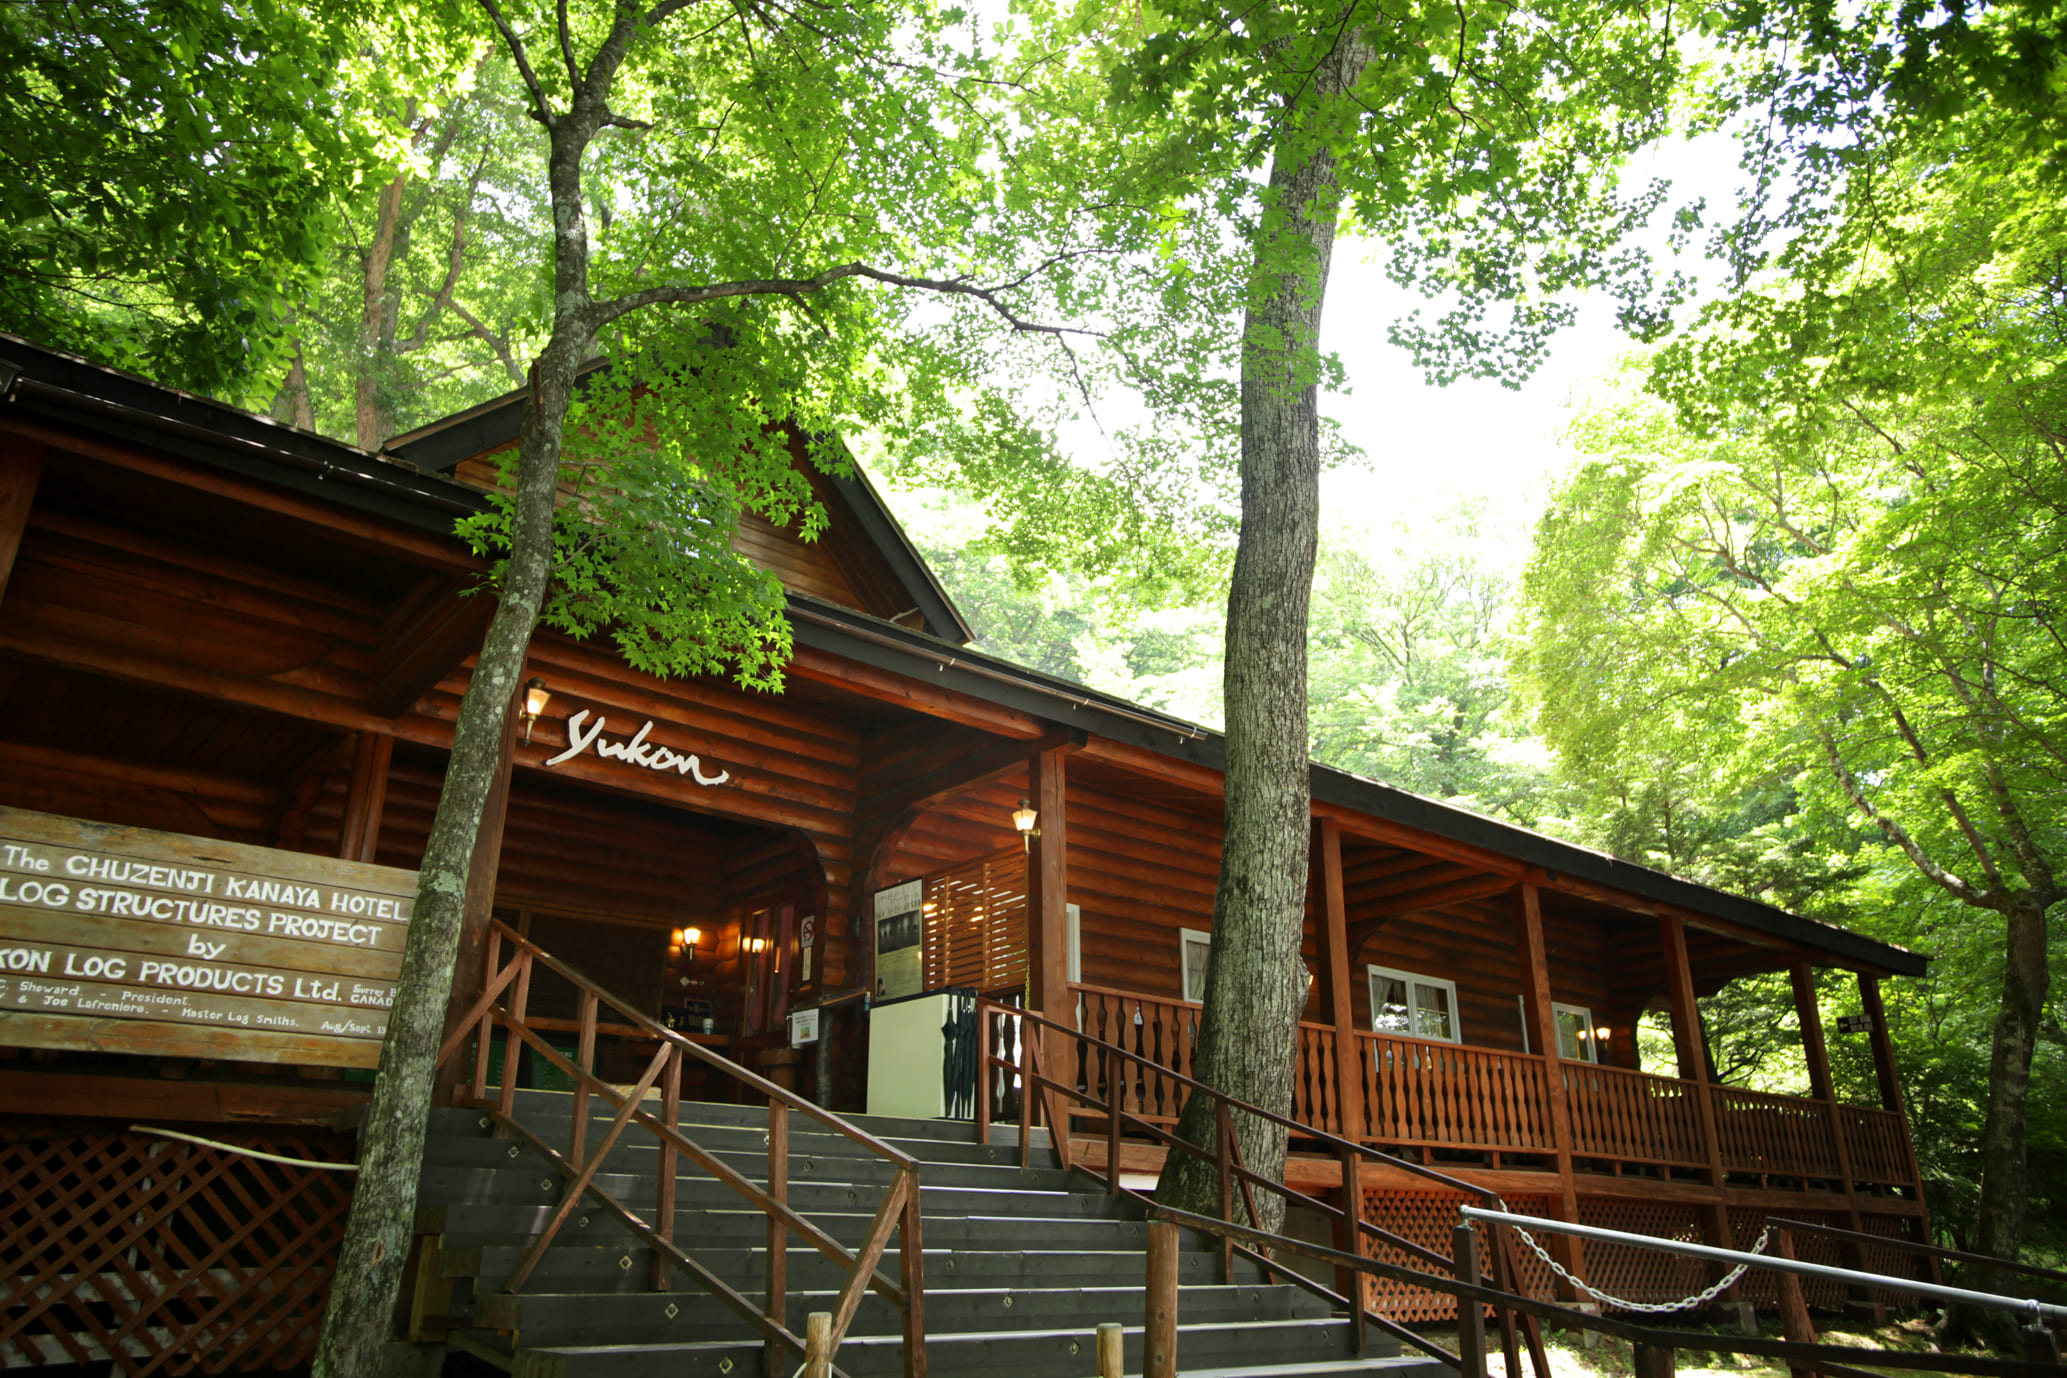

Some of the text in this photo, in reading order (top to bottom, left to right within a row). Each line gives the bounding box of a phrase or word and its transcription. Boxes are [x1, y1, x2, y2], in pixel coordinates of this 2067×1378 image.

[546, 709, 729, 785] Yukon
[0, 877, 382, 945] LOG STRUCTURES PROJECT
[4, 845, 408, 922] The CHUZENJI KANAYA HOTEL
[187, 934, 226, 960] by
[64, 953, 127, 979] LOG
[138, 961, 284, 995] PRODUCTS
[293, 978, 342, 1002] Ltd.
[43, 995, 68, 1006] Joe
[182, 1007, 223, 1020] Master
[228, 1012, 248, 1025] Log
